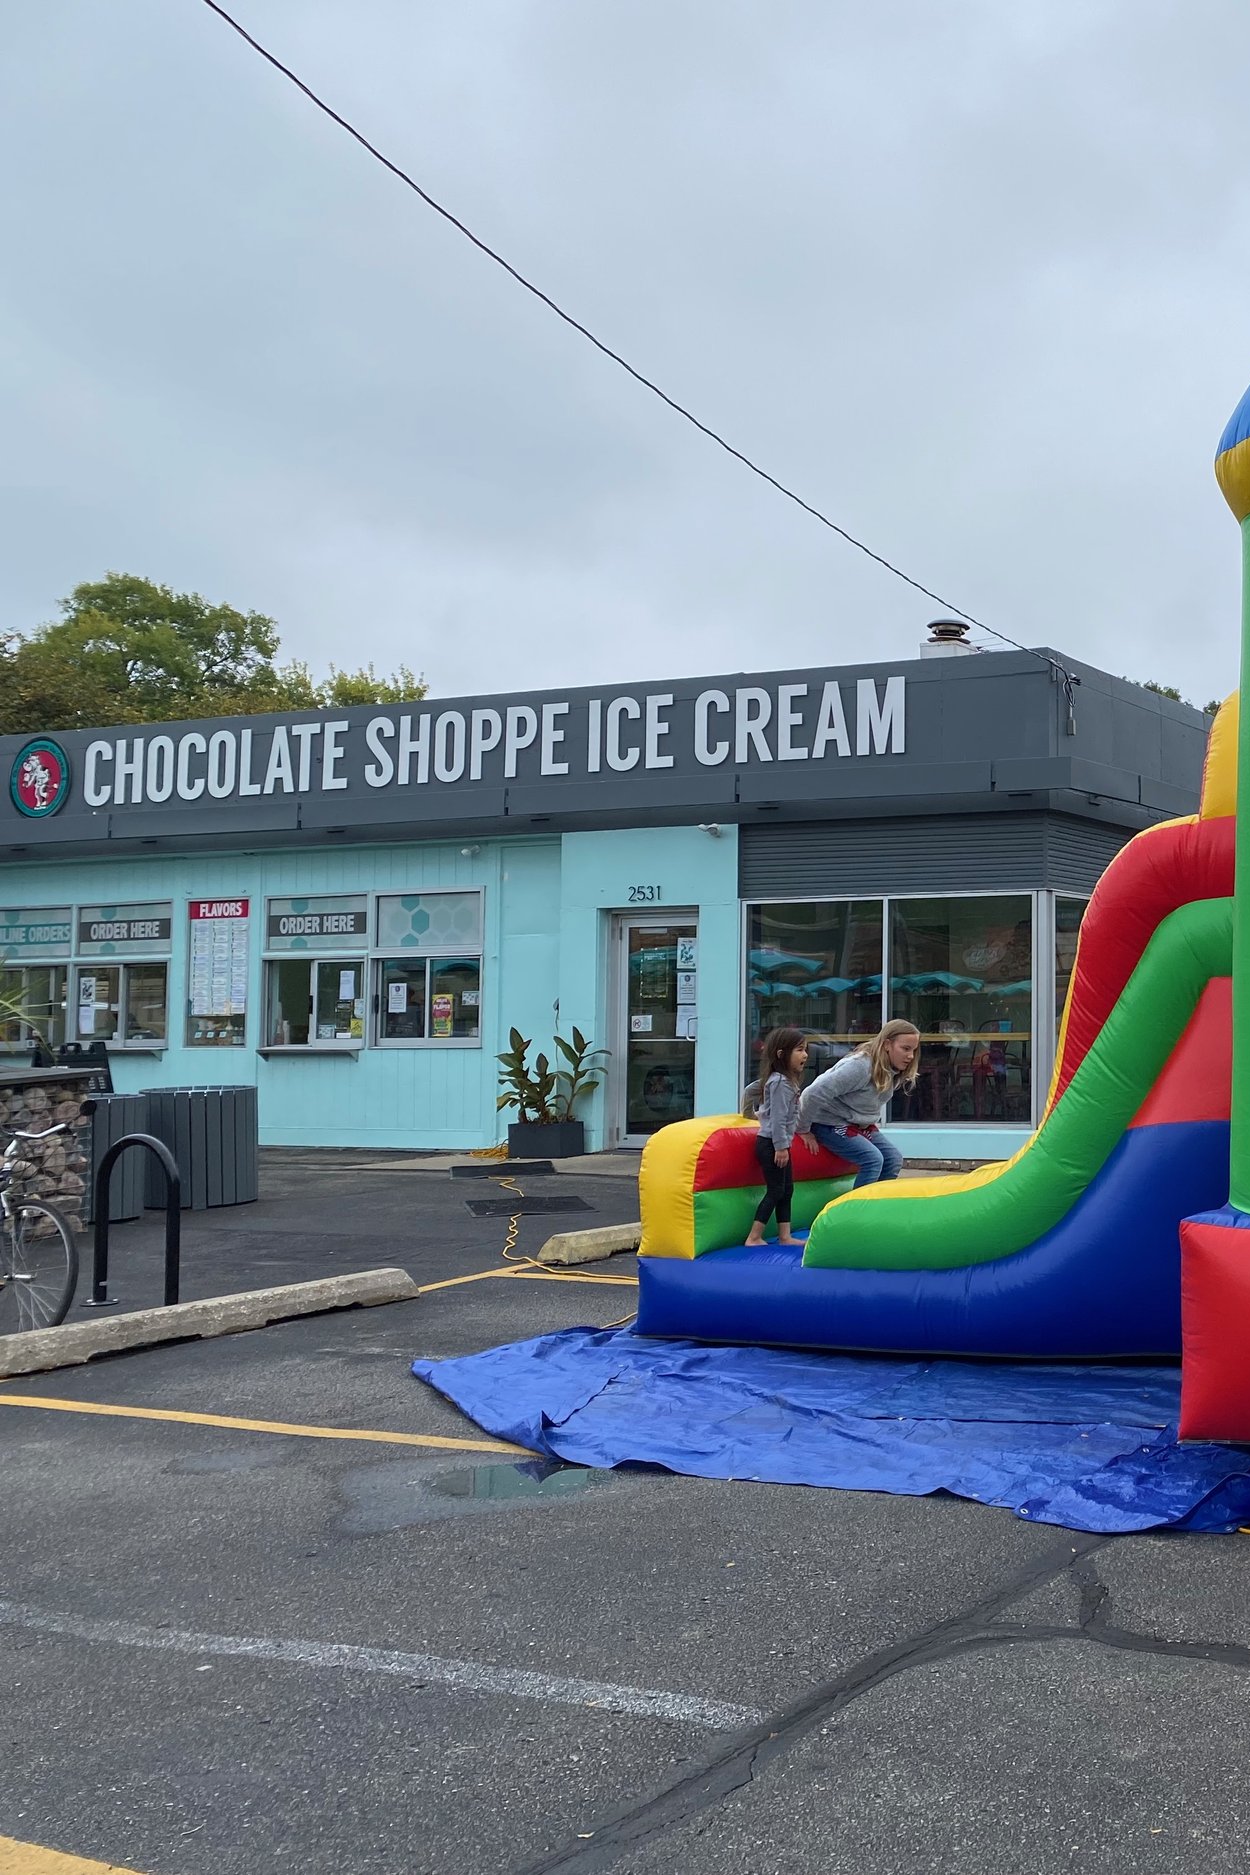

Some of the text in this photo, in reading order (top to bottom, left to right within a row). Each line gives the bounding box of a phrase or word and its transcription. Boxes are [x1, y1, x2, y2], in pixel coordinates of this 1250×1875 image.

[83, 720, 349, 807] CHOCOLATE
[364, 703, 569, 788] SHOPPE
[587, 694, 674, 773] ICE
[694, 676, 905, 767] CREAM
[628, 885, 662, 902] 2531
[199, 902, 243, 918] FLAVORS
[90, 921, 160, 940] ORDER HERE
[280, 914, 355, 934] ORDER HERE
[28, 925, 71, 942] ORDERS
